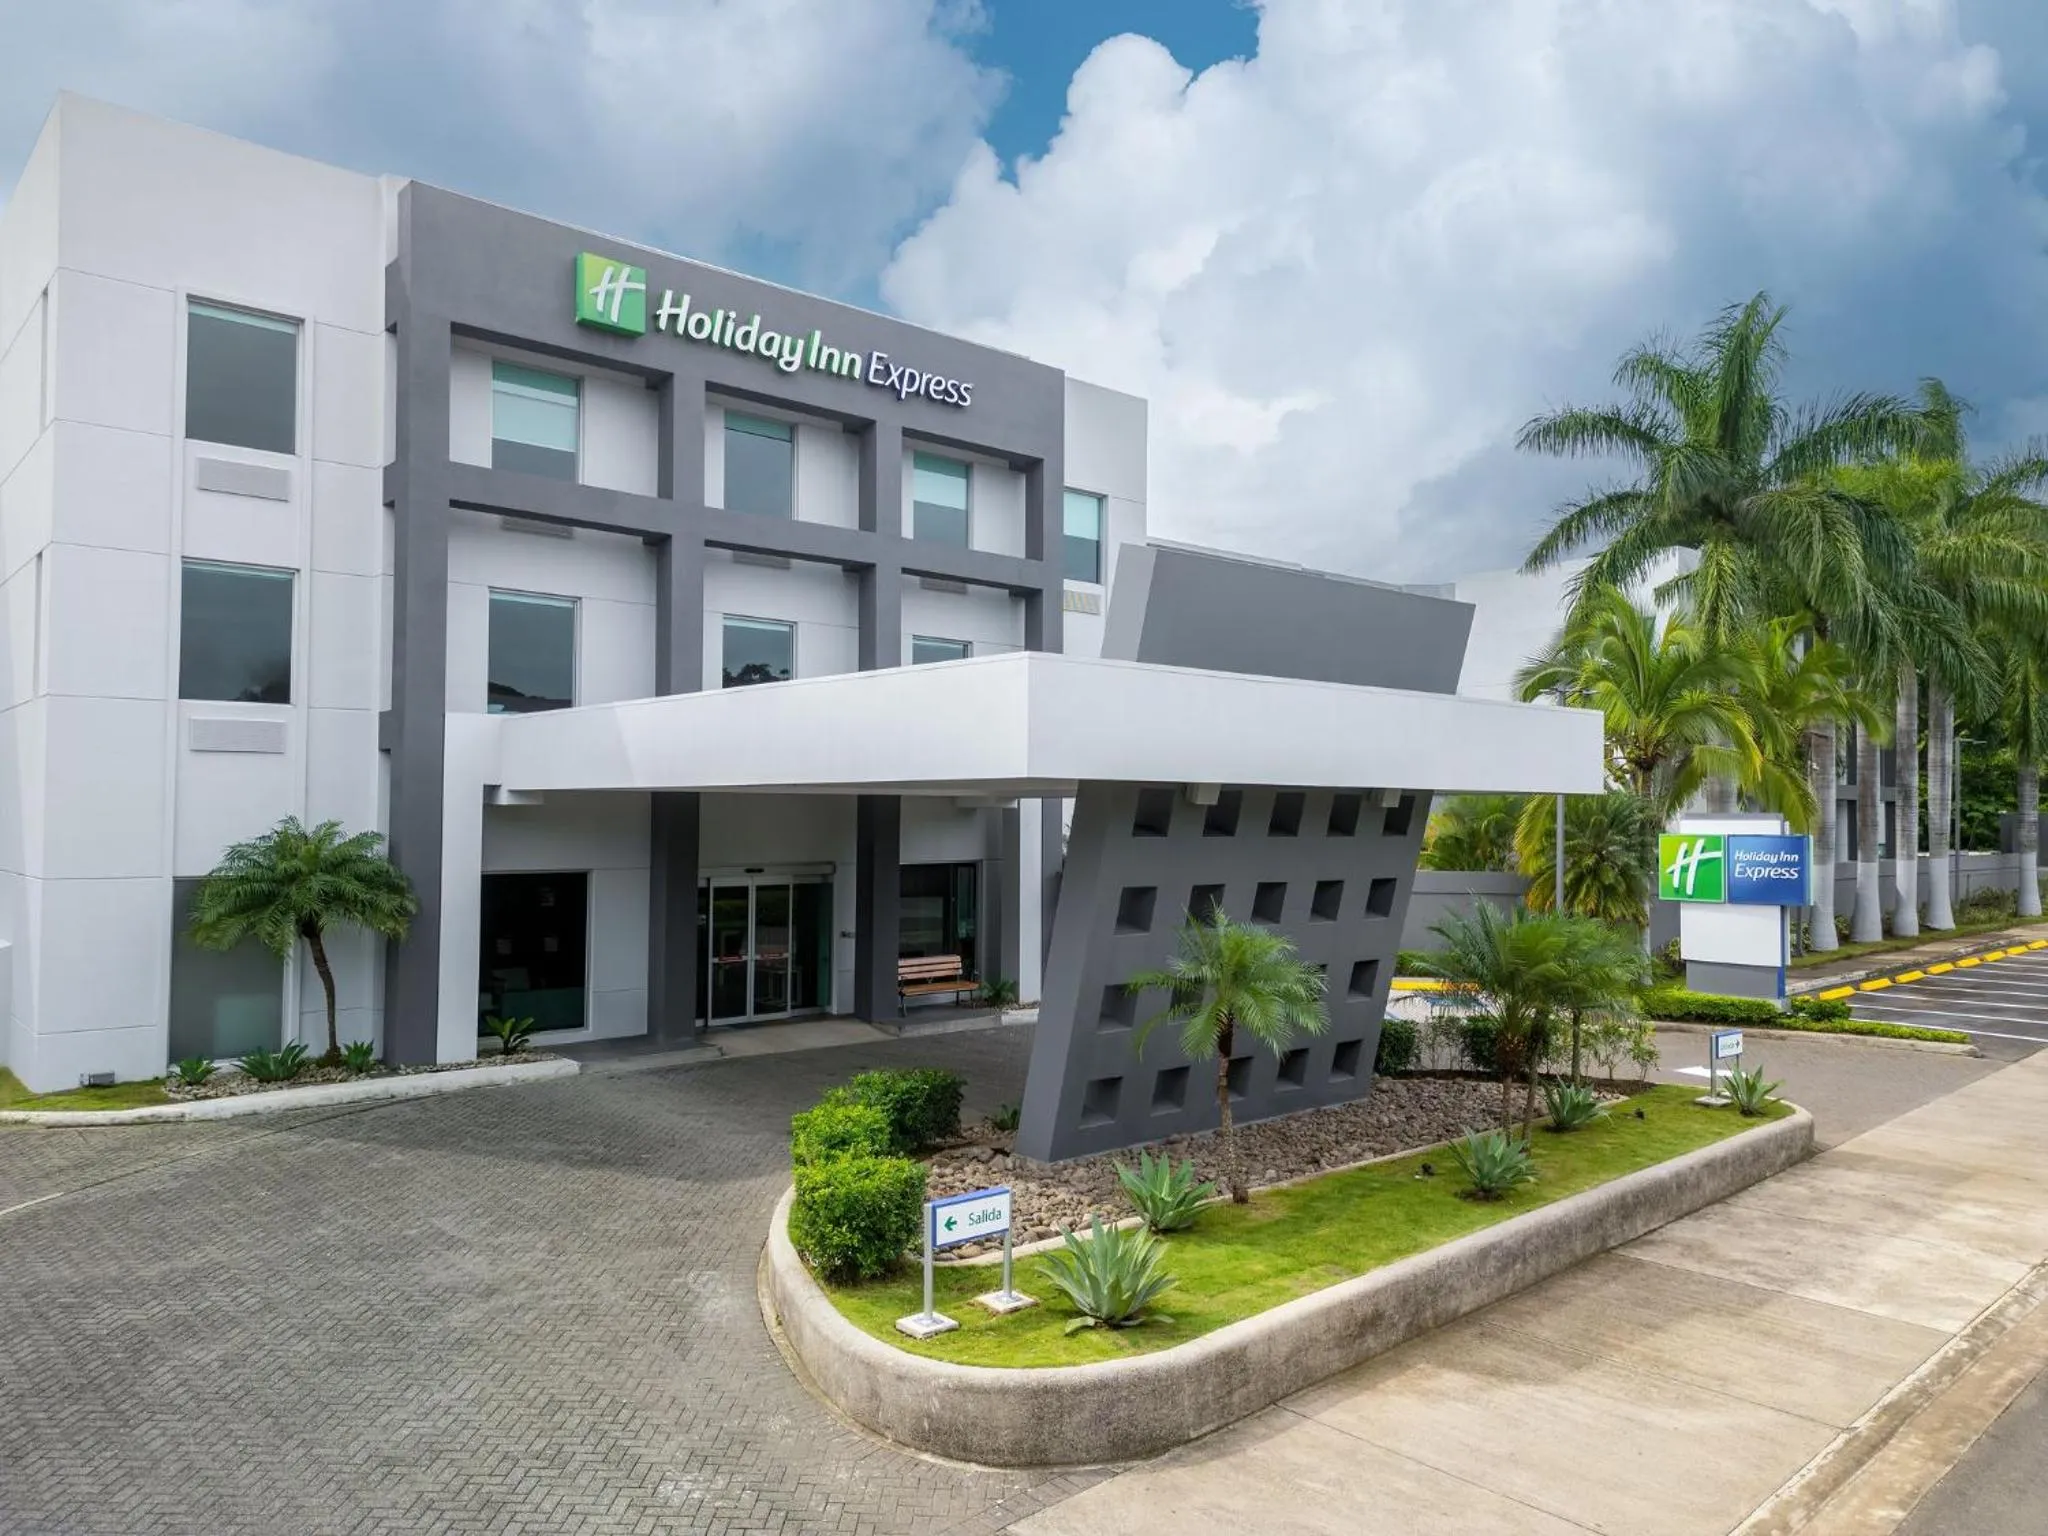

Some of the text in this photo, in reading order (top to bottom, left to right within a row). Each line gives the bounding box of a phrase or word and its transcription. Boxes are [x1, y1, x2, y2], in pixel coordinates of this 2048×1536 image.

[656, 288, 973, 408] Holiday Inn Express
[1735, 849, 1799, 864] Holiday Inn
[1734, 862, 1800, 882] Express
[968, 1207, 1002, 1226] Salida
